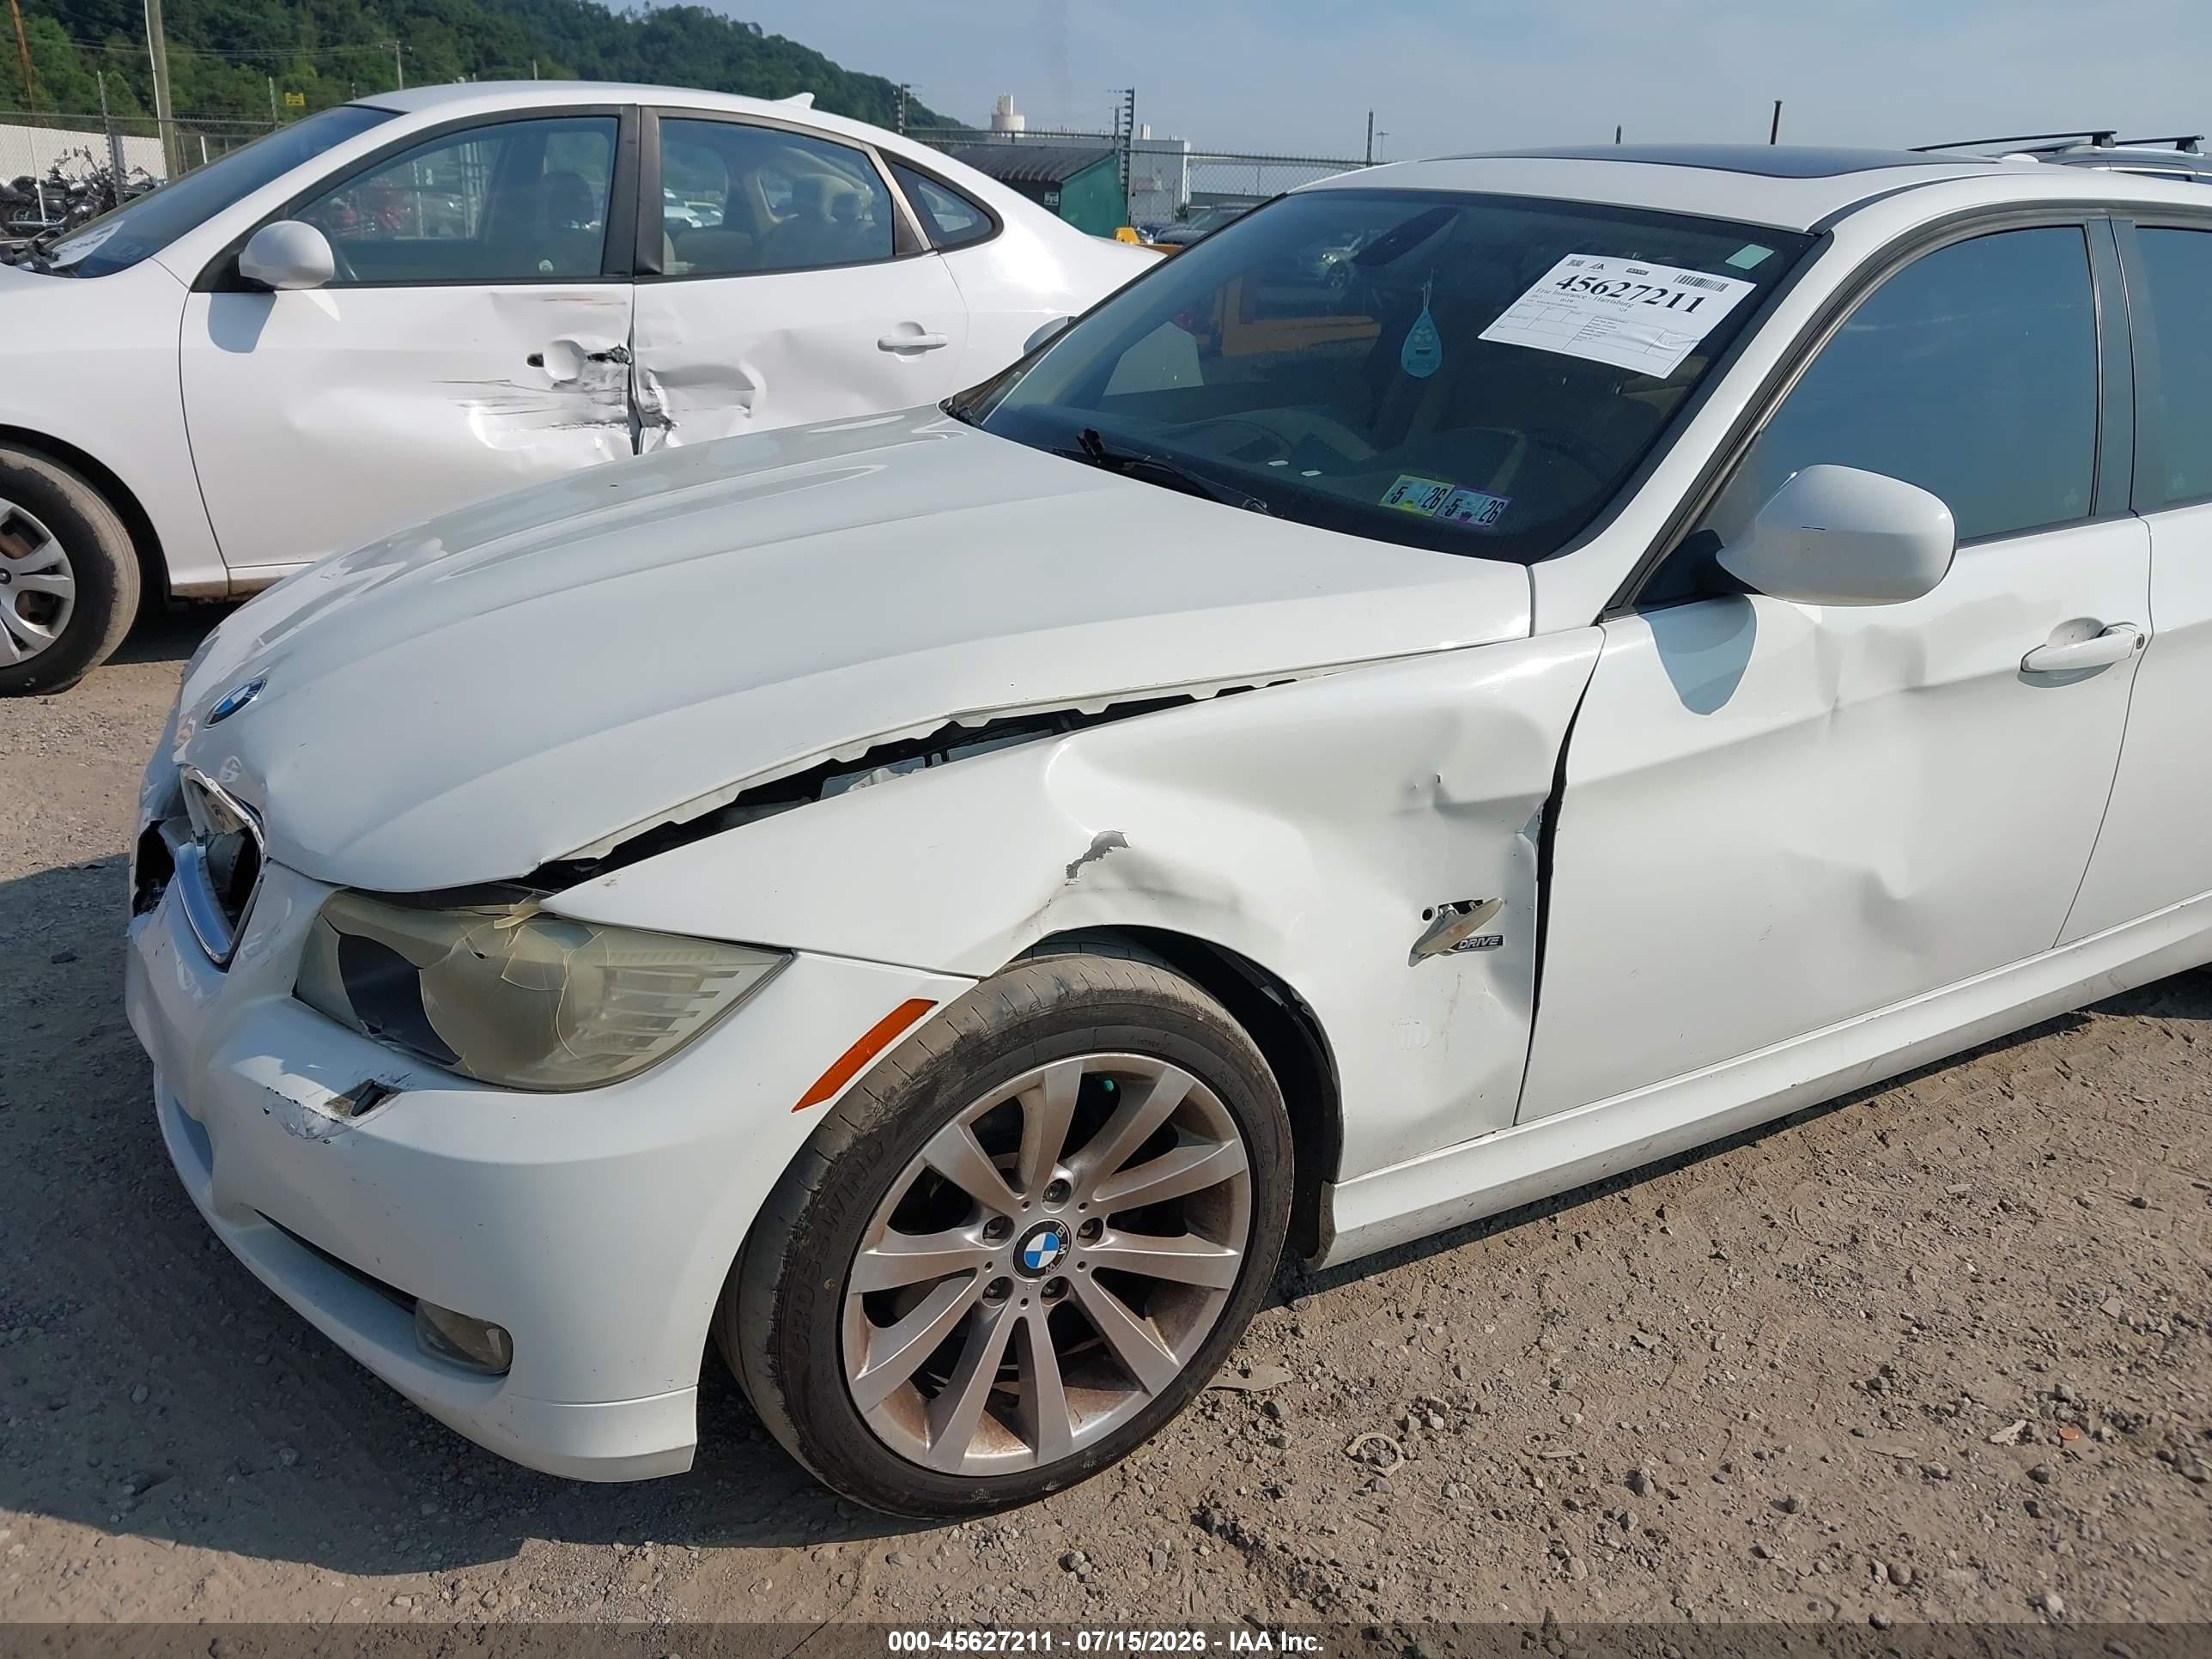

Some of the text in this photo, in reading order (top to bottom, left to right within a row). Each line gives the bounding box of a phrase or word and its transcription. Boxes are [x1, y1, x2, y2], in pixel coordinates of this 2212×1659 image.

[1552, 289, 1587, 300] Insurance
[1594, 295, 1634, 309] Harrisburg
[1555, 274, 1706, 314] 45627211
[1390, 486, 1448, 510] 5 26
[1444, 498, 1504, 524] 5 26
[1045, 1225, 1067, 1275] BMW
